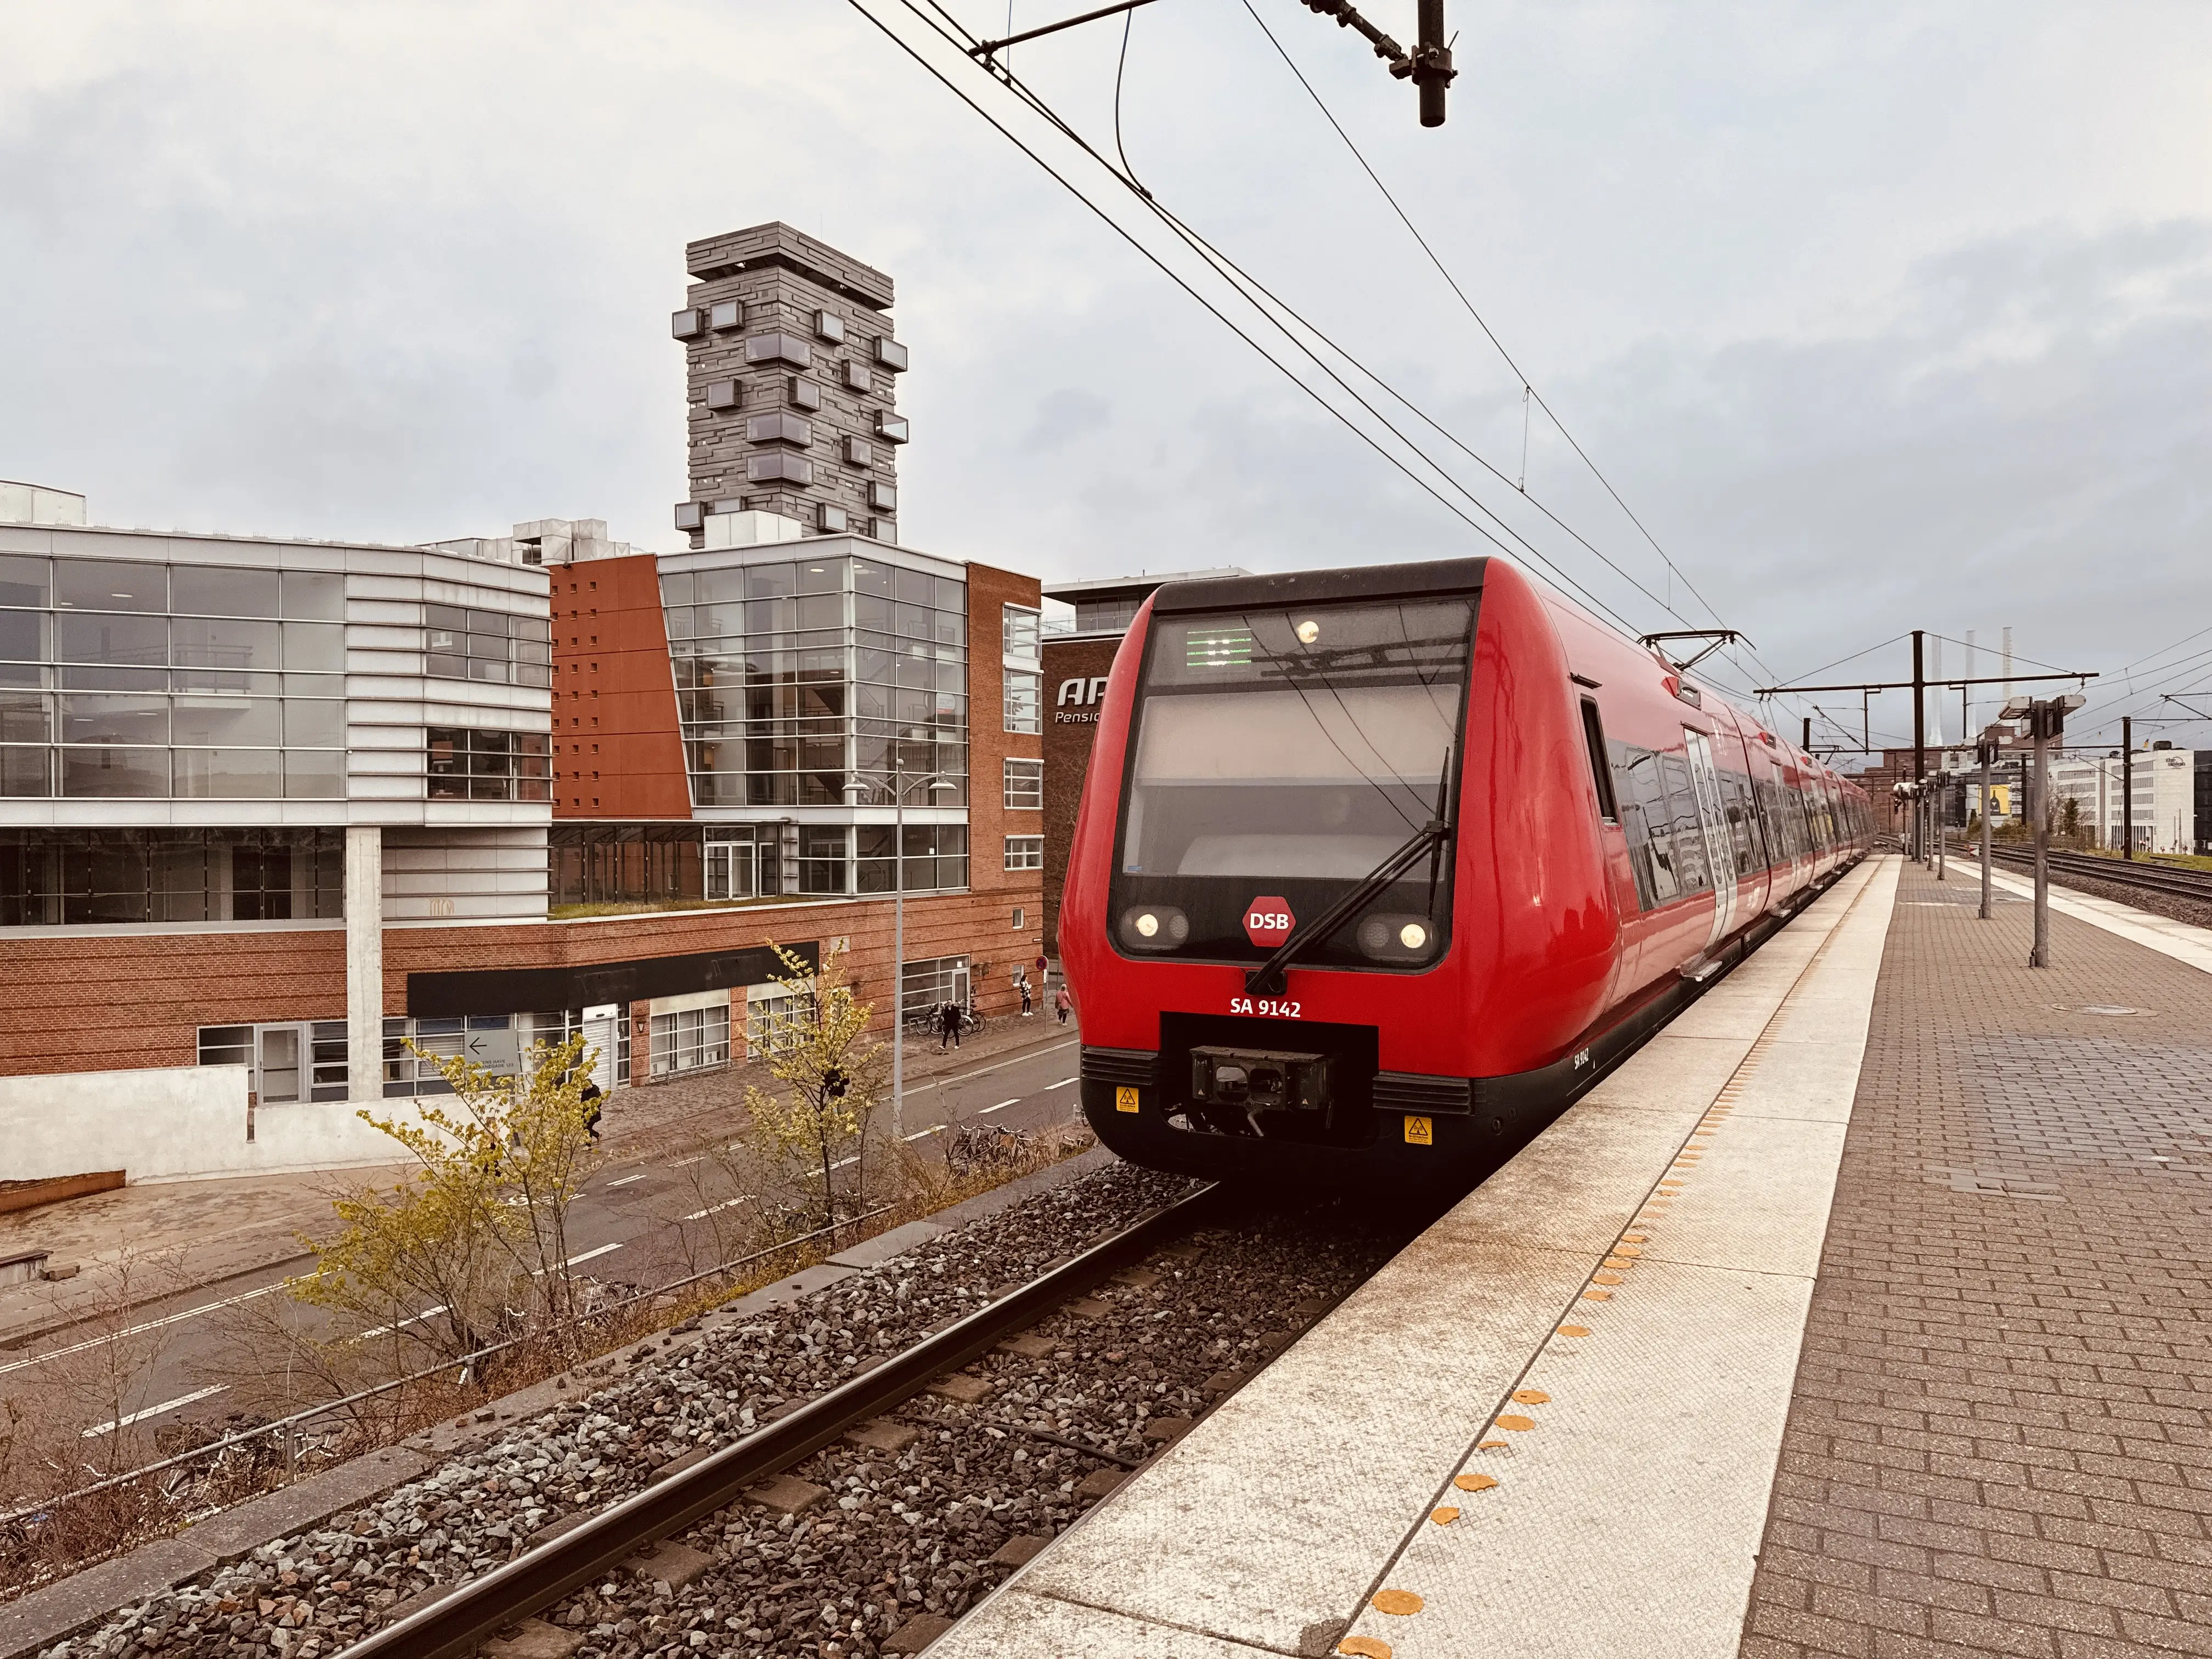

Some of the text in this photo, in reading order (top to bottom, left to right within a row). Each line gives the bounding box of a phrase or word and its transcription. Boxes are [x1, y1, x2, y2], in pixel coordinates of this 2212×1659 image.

[1250, 913, 1289, 929] DSB
[1230, 998, 1301, 1018] SA 9142
[1575, 1047, 1589, 1070] SA 9142
